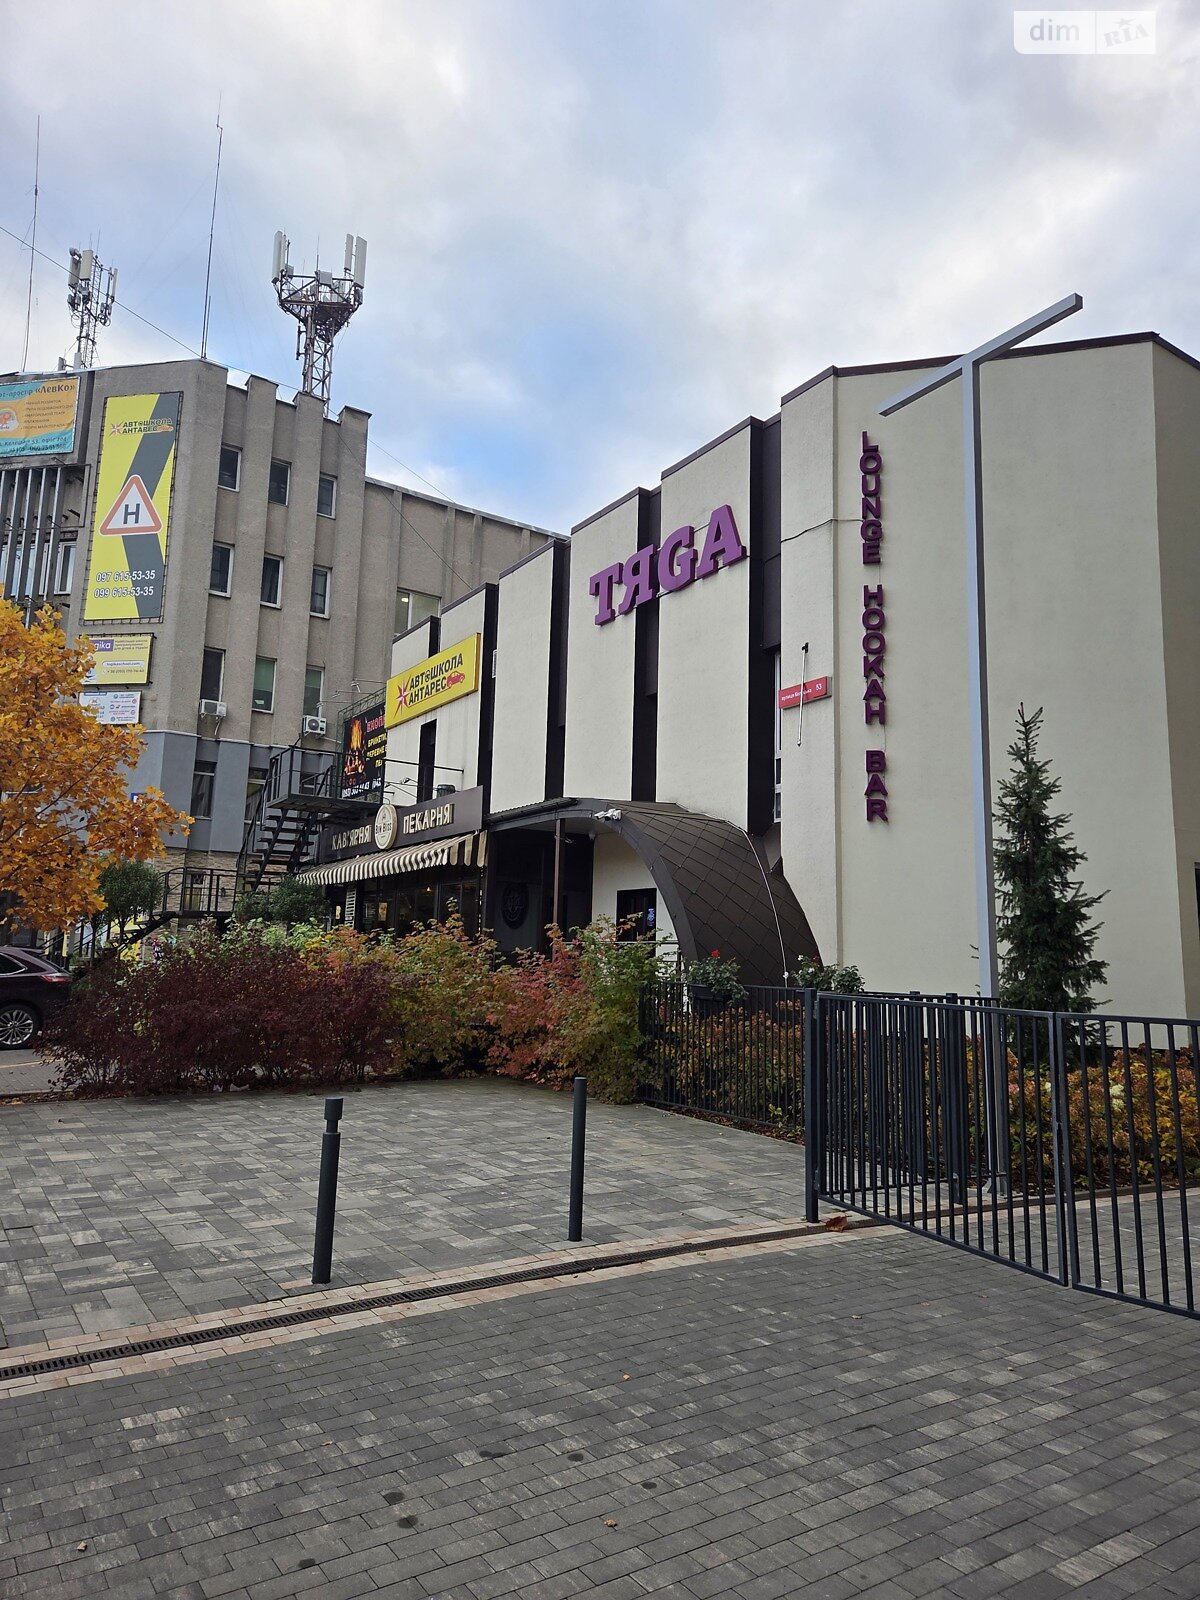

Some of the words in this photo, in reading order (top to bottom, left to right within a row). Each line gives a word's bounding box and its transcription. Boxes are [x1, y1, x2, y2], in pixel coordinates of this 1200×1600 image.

[860, 431, 882, 564] LOUNGE
[96, 571, 112, 582] 097
[113, 569, 156, 582] 615-53-35
[94, 587, 110, 598] 099
[112, 585, 154, 597] 615-53-35
[862, 584, 886, 725] HOOKAH
[409, 653, 463, 690] АВТОШКОЛА
[815, 683, 822, 691] 53
[408, 676, 447, 705] АНТАРЕС
[865, 750, 888, 822] BAR
[403, 803, 455, 834] ПЕКАРНЯ
